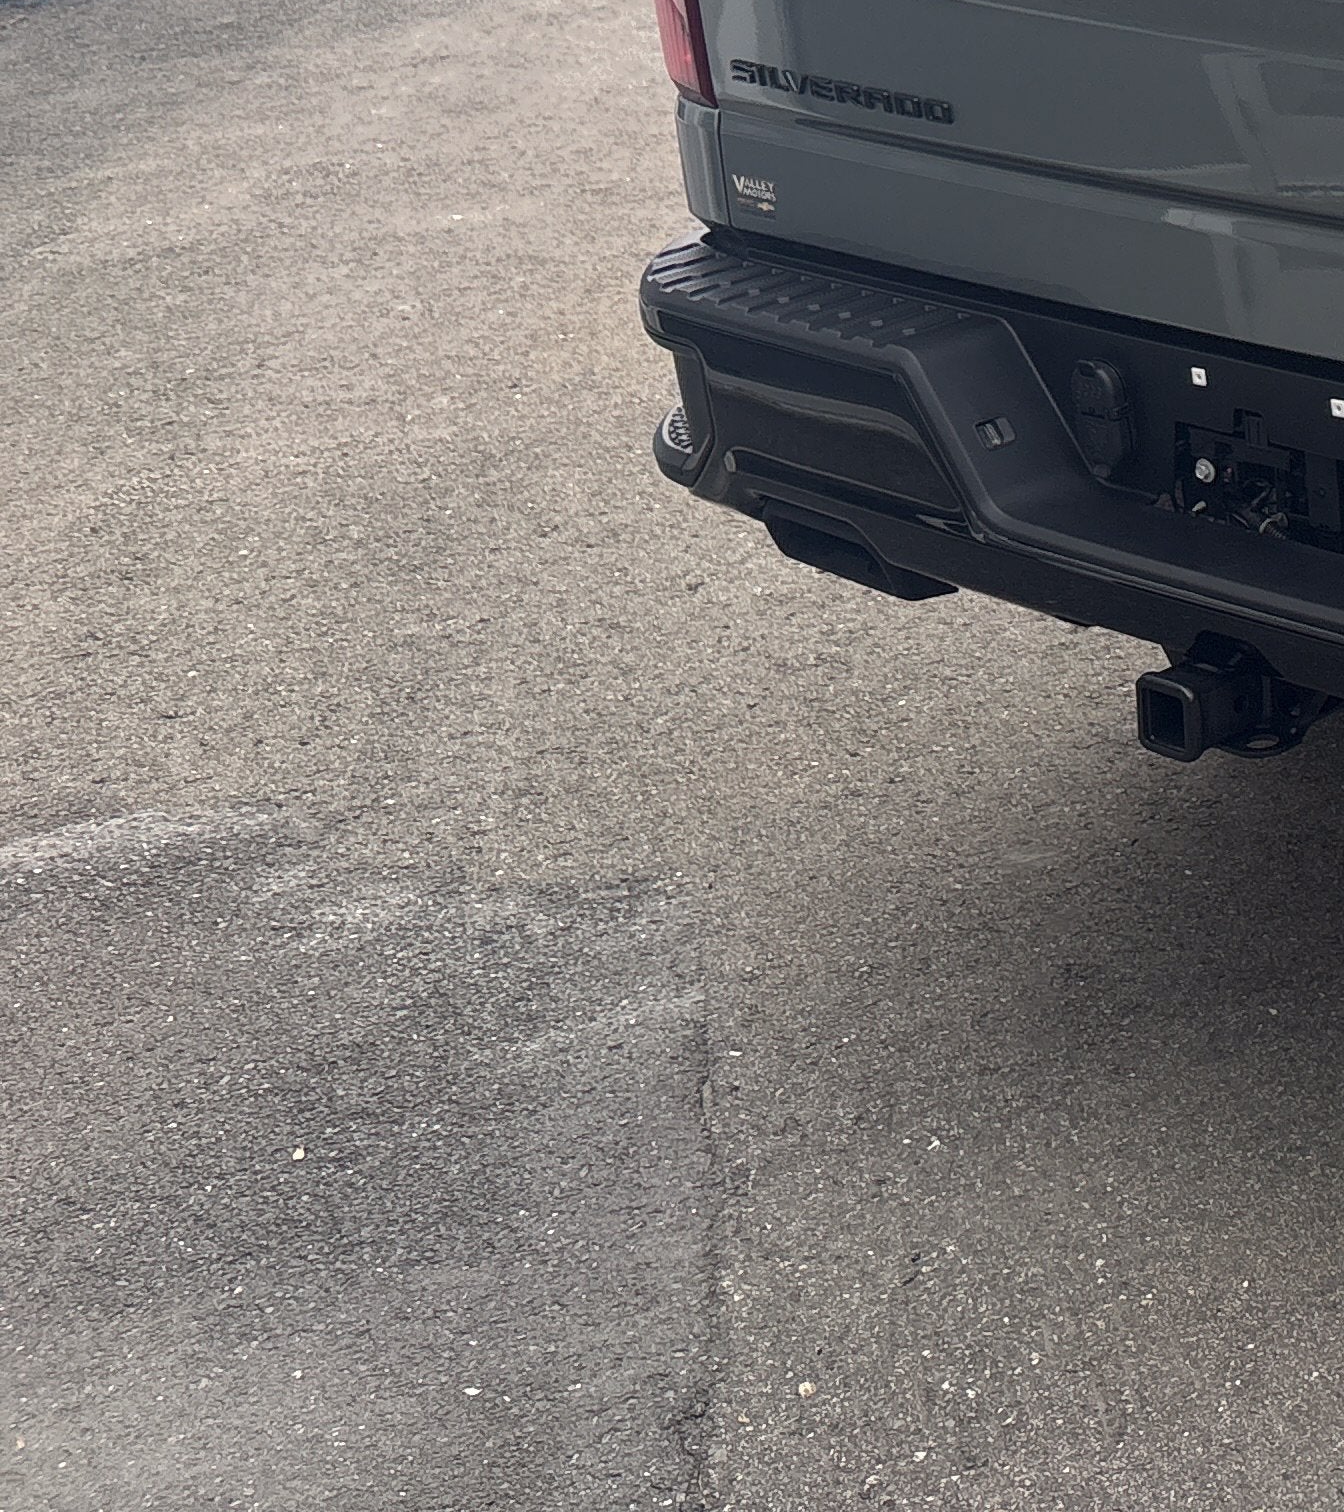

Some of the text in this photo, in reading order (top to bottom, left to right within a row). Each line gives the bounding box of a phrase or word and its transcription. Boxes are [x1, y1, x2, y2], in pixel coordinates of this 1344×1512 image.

[730, 59, 955, 125] SILVERADO
[732, 174, 774, 193] VALLEY
[743, 187, 777, 202] MOTORS
